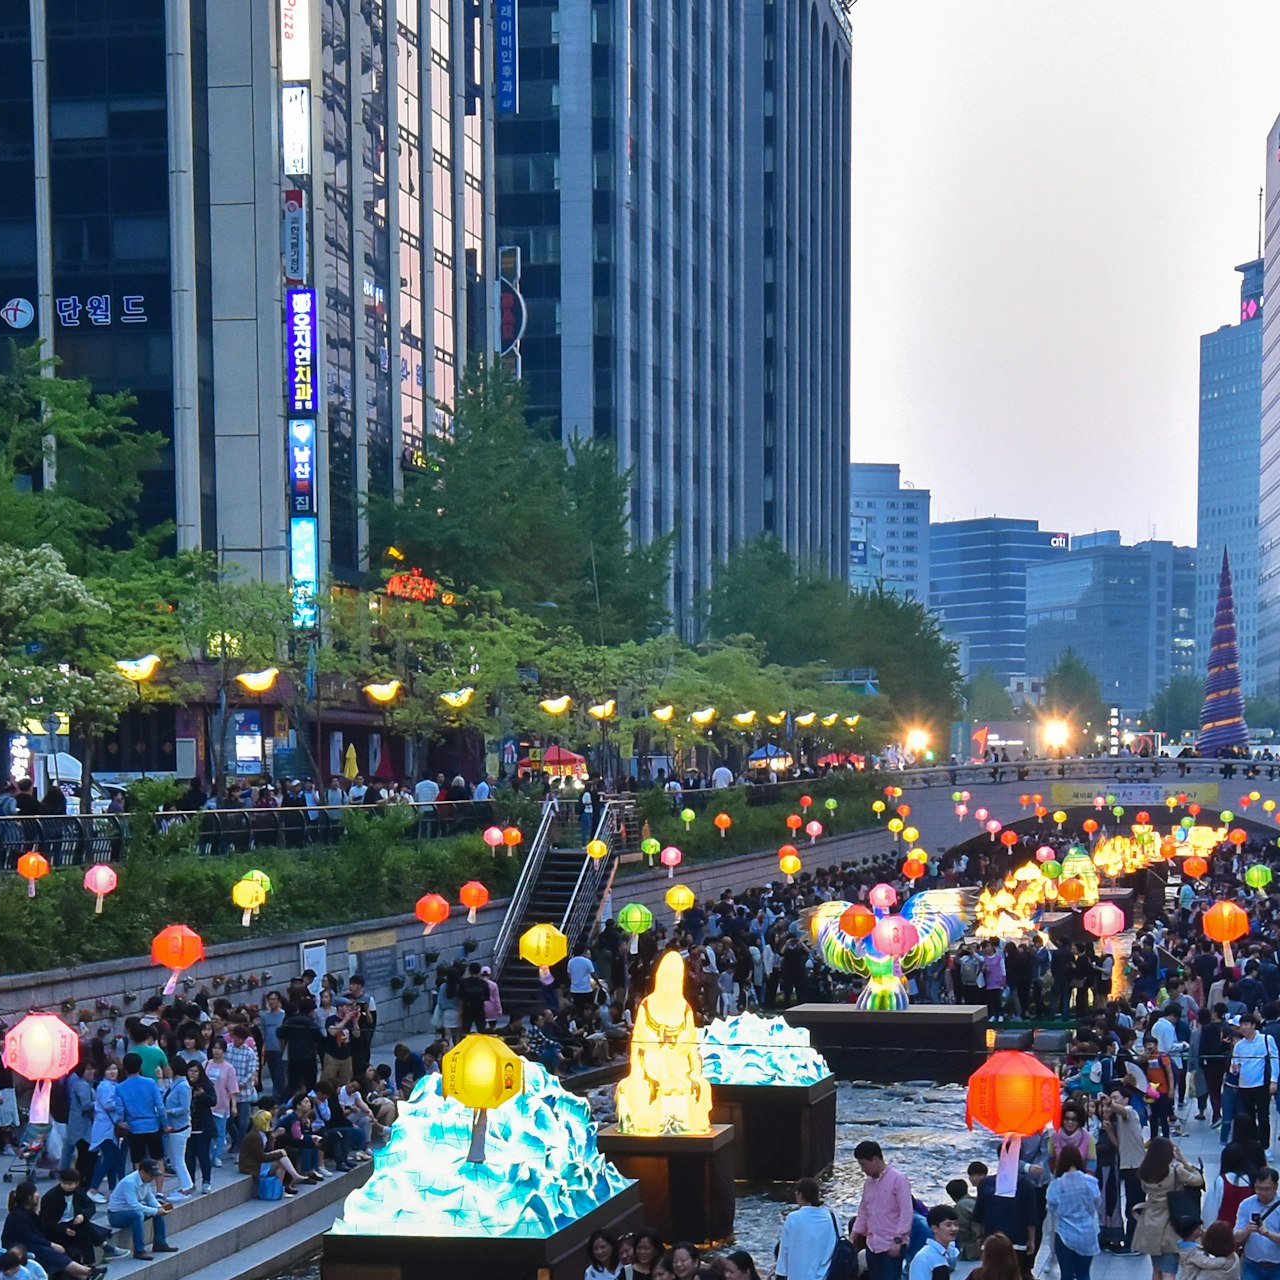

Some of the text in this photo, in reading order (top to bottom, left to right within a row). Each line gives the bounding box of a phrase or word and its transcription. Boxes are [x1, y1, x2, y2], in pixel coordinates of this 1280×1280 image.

[500, 0, 513, 93] 래이비인후과
[55, 294, 148, 327] 단월드
[1050, 535, 1067, 548] citi
